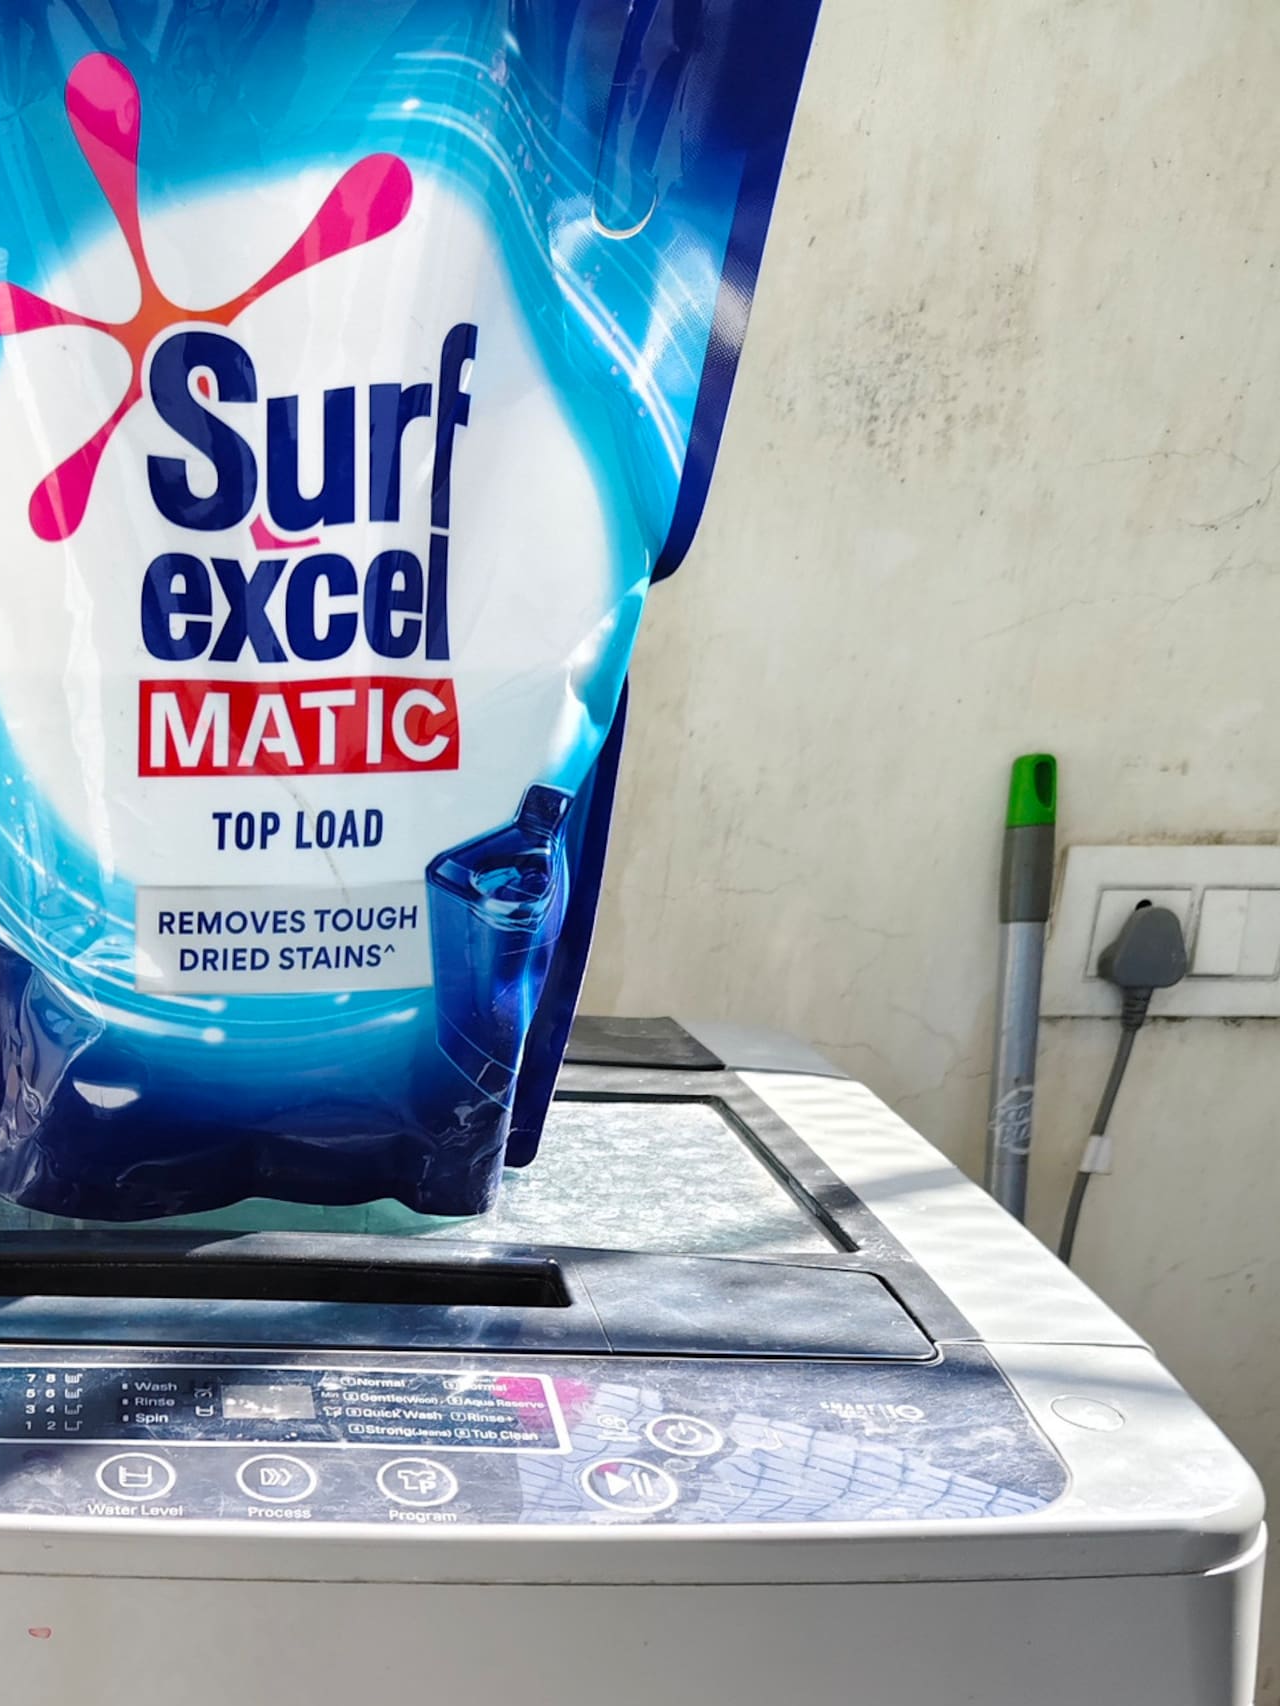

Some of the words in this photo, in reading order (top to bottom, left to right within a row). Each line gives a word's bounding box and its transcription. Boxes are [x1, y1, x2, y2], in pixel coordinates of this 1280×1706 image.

[147, 323, 478, 531] Surf
[141, 533, 450, 663] excel
[150, 688, 451, 767] MATIC
[213, 811, 281, 851] TOP
[295, 808, 385, 850] LOAD
[158, 910, 306, 935] REMOVES
[314, 905, 418, 932] TOUGH
[180, 948, 269, 972] DRIED
[26, 1373, 37, 1384] 7
[45, 1373, 56, 1384] 8
[356, 1378, 406, 1388] Normal
[134, 1381, 178, 1392] Wash
[25, 1389, 36, 1399] 5
[45, 1389, 56, 1399] 6
[134, 1397, 175, 1407] Rinse
[463, 1398, 496, 1408] Aqua
[496, 1399, 545, 1409] Reserve
[25, 1405, 36, 1415] 3
[45, 1405, 56, 1415] 4
[362, 1408, 402, 1419] Quick
[403, 1410, 443, 1421] Wash
[135, 1412, 170, 1424] Spin
[47, 1421, 57, 1431] 2
[471, 1429, 498, 1439] Tub
[500, 1430, 539, 1441] Clean
[87, 1503, 137, 1517] Water
[141, 1504, 184, 1517] Level
[247, 1506, 312, 1520] Process
[389, 1509, 457, 1524] Program
